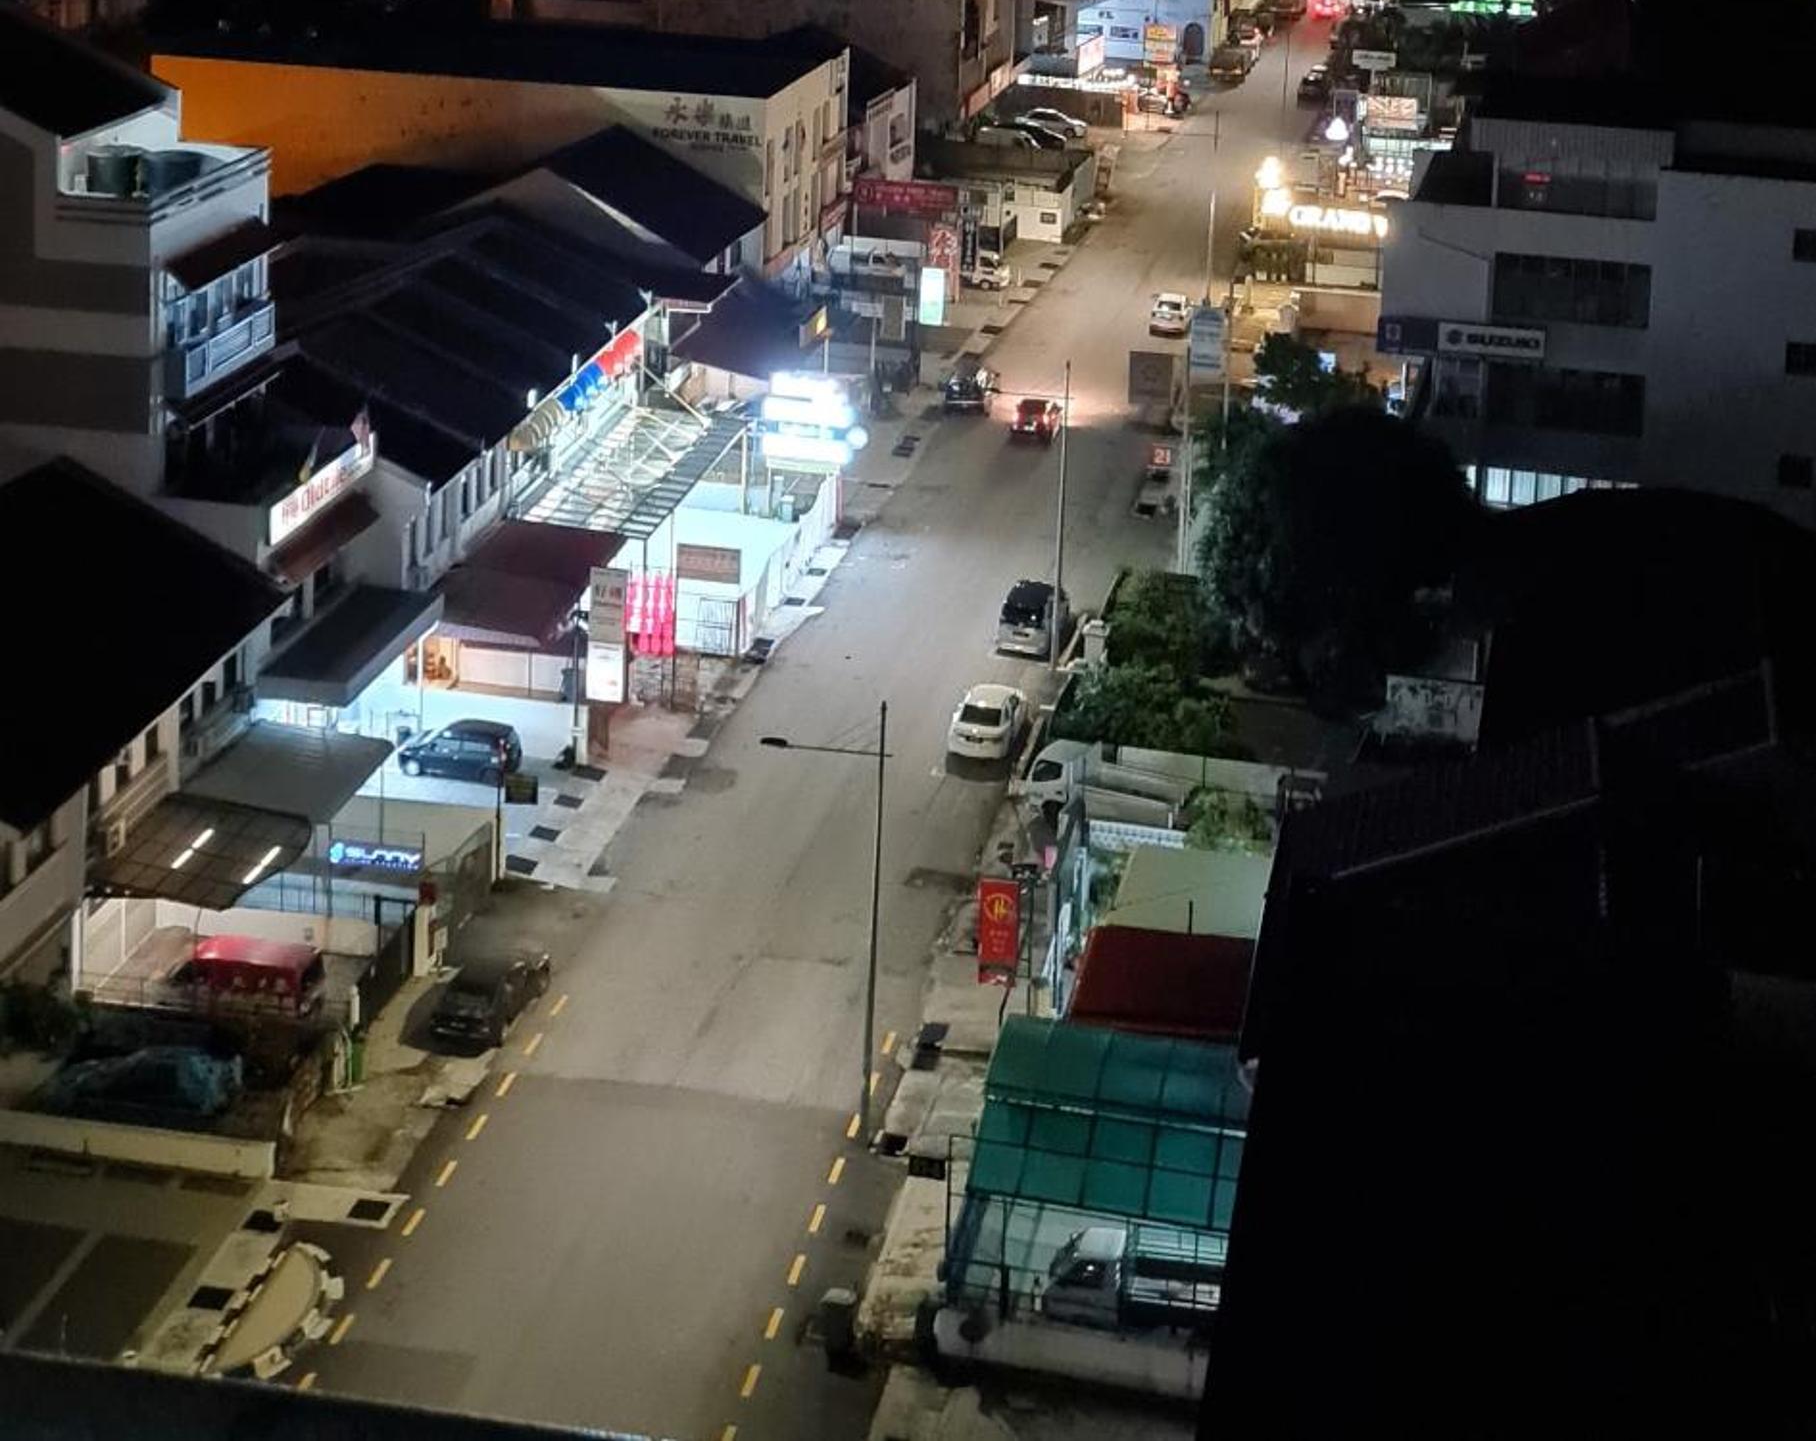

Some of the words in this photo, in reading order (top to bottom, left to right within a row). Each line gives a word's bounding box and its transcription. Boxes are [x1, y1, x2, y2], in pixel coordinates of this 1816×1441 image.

[652, 127, 711, 143] FOREVER
[715, 131, 763, 147] TRAVEL
[1466, 333, 1540, 350] SUZUKI
